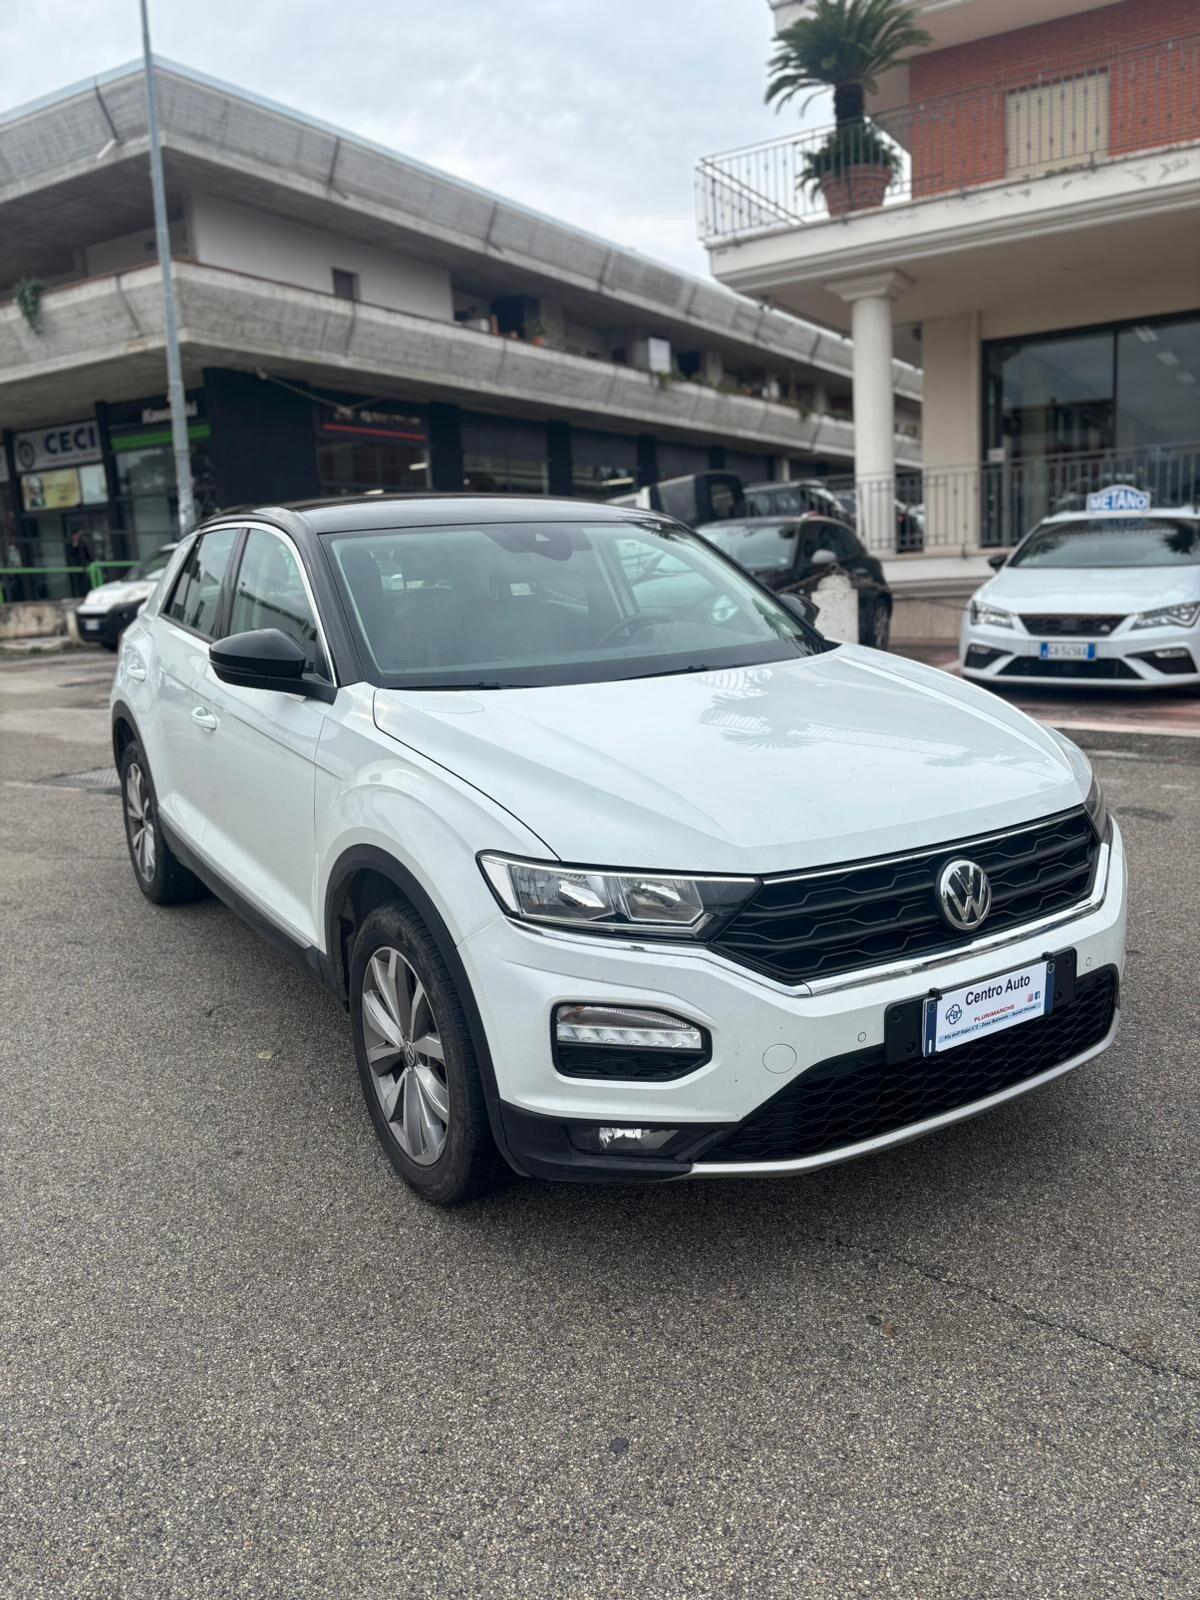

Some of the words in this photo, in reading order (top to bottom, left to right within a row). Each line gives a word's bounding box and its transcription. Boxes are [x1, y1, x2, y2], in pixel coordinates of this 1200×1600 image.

[44, 427, 95, 454] CECI
[1090, 489, 1147, 510] METANO
[965, 985, 1003, 1005] Centro
[1005, 976, 1030, 993] Auto
[974, 1004, 1015, 1022] PLURIMARCHE
